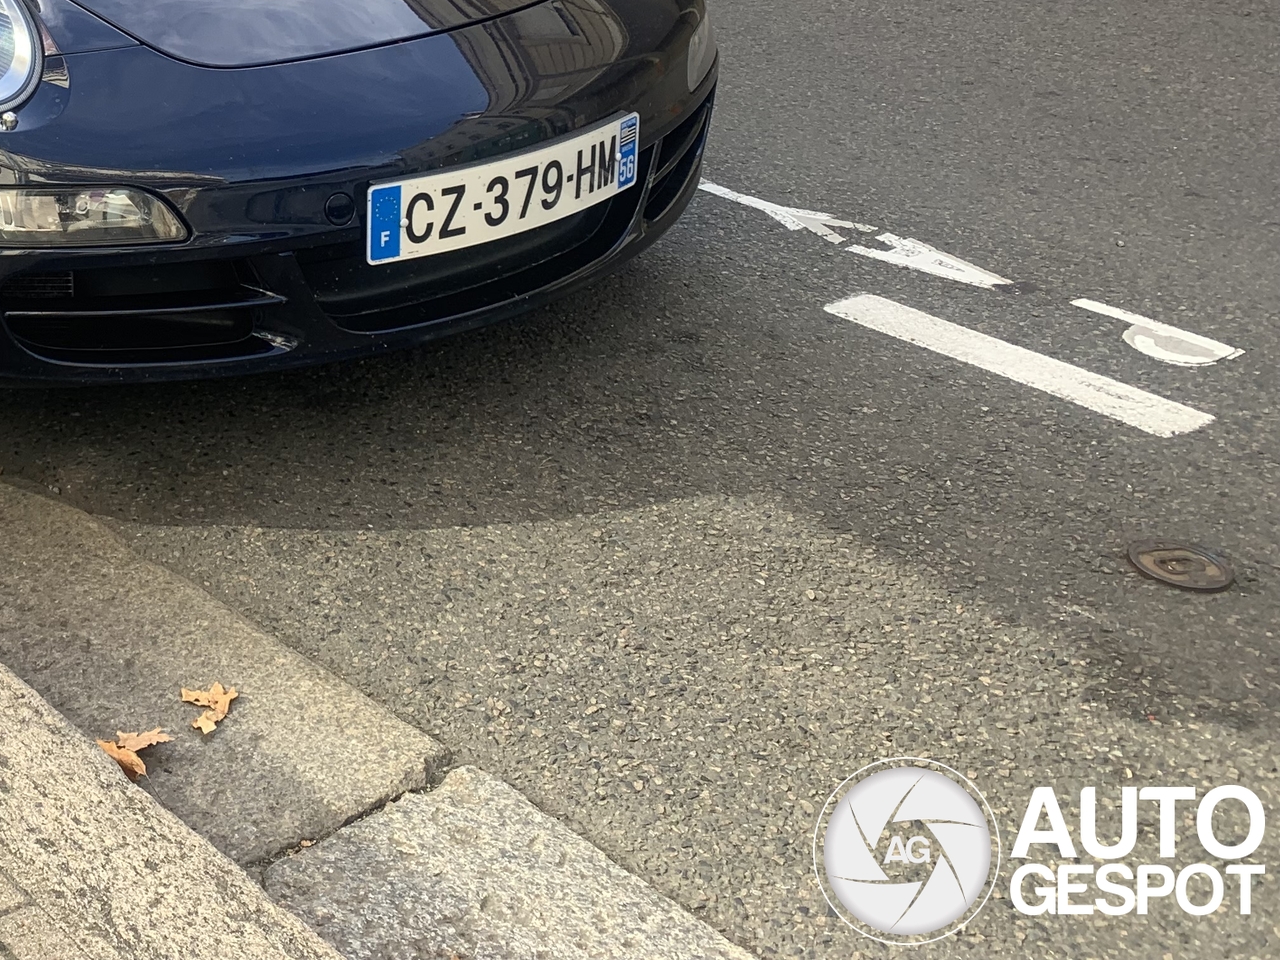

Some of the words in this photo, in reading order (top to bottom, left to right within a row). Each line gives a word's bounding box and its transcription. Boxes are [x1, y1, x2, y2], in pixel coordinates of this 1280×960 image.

[380, 231, 390, 247] F
[405, 135, 617, 244] CZ-379-HM
[620, 154, 634, 181] 56
